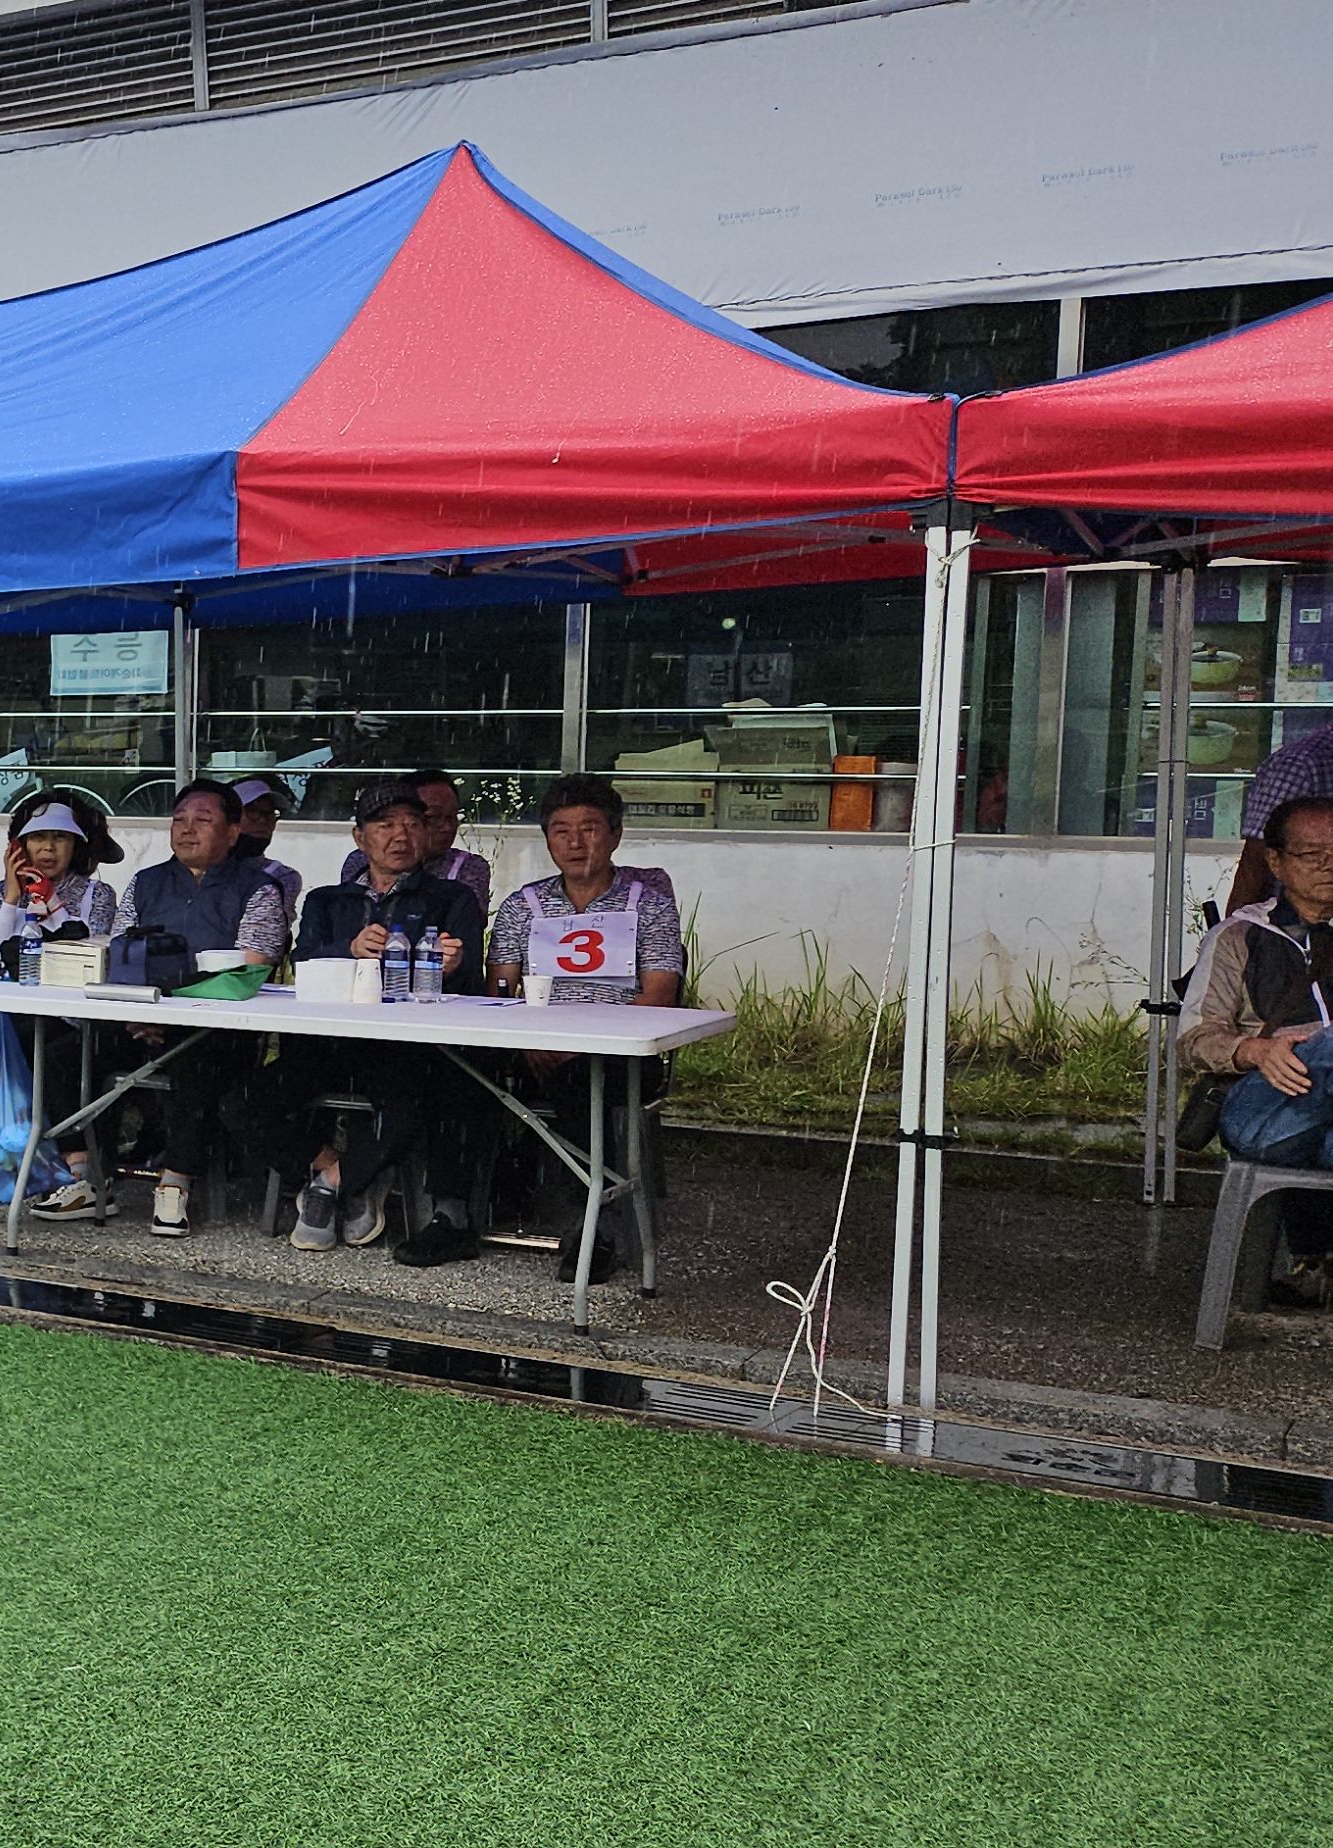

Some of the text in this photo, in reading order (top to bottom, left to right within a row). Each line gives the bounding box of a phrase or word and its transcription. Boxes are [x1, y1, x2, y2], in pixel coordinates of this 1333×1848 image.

[1042, 168, 1084, 182] Parasol
[875, 188, 915, 203] Parasol
[918, 186, 944, 196] Dark
[717, 208, 756, 222] Parasol
[556, 929, 606, 974] 3
